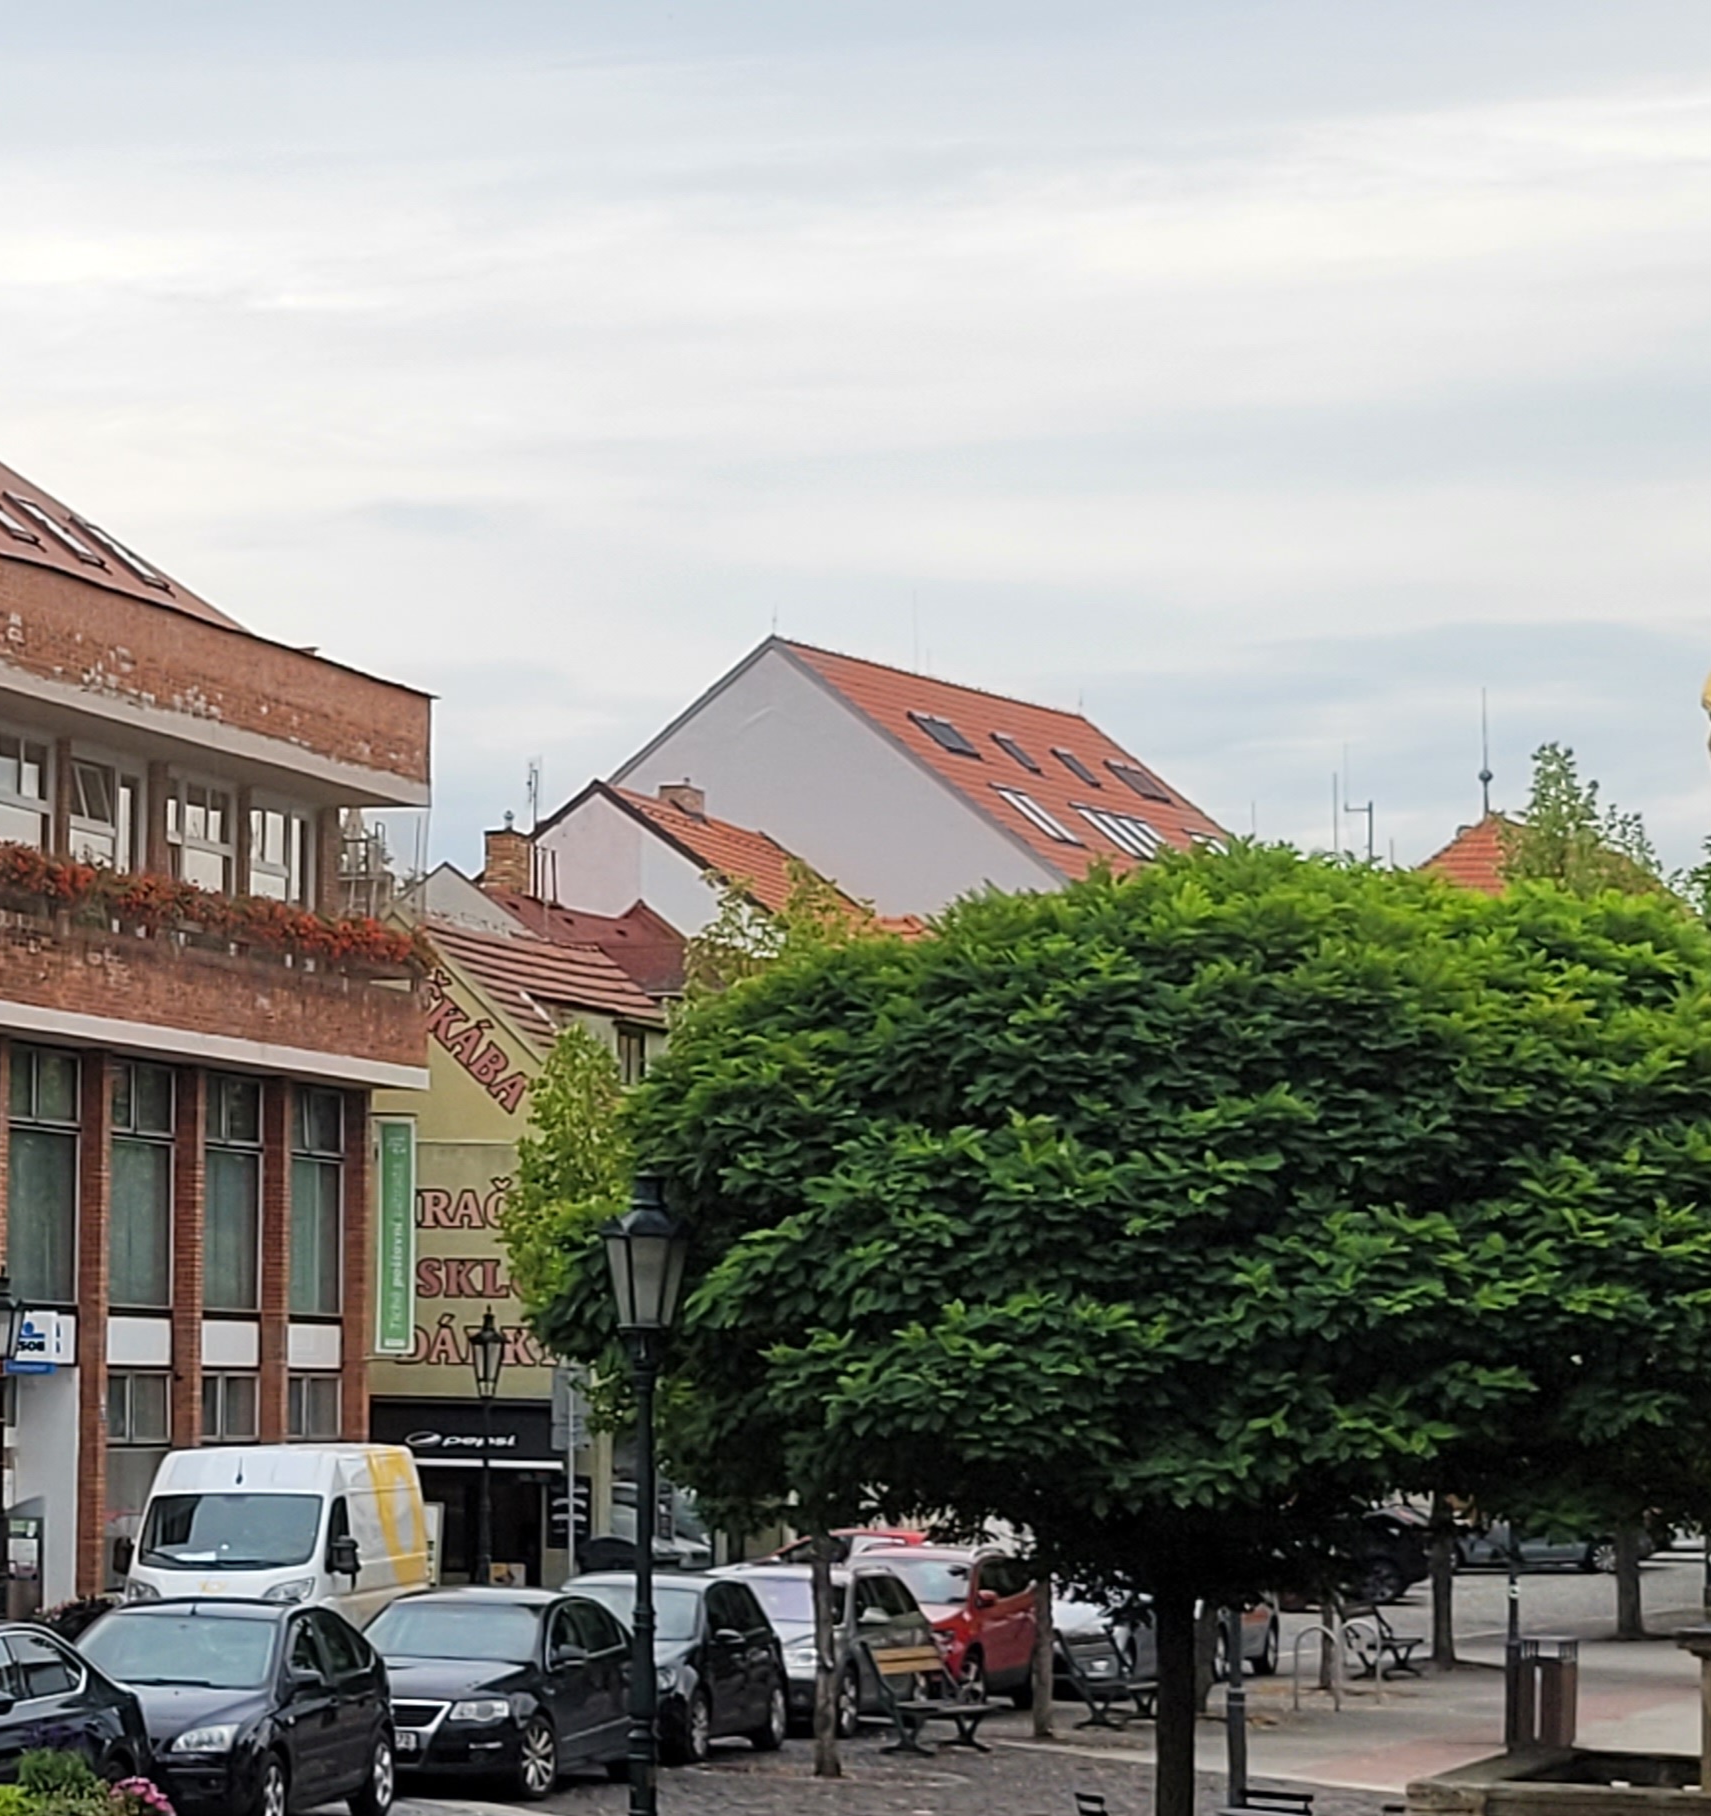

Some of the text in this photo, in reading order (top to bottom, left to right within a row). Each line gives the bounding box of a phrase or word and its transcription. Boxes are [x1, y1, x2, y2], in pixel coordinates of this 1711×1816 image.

[416, 1177, 512, 1229] RAČ
[416, 1258, 523, 1299] SKL
[441, 1435, 516, 1447] pepsi
